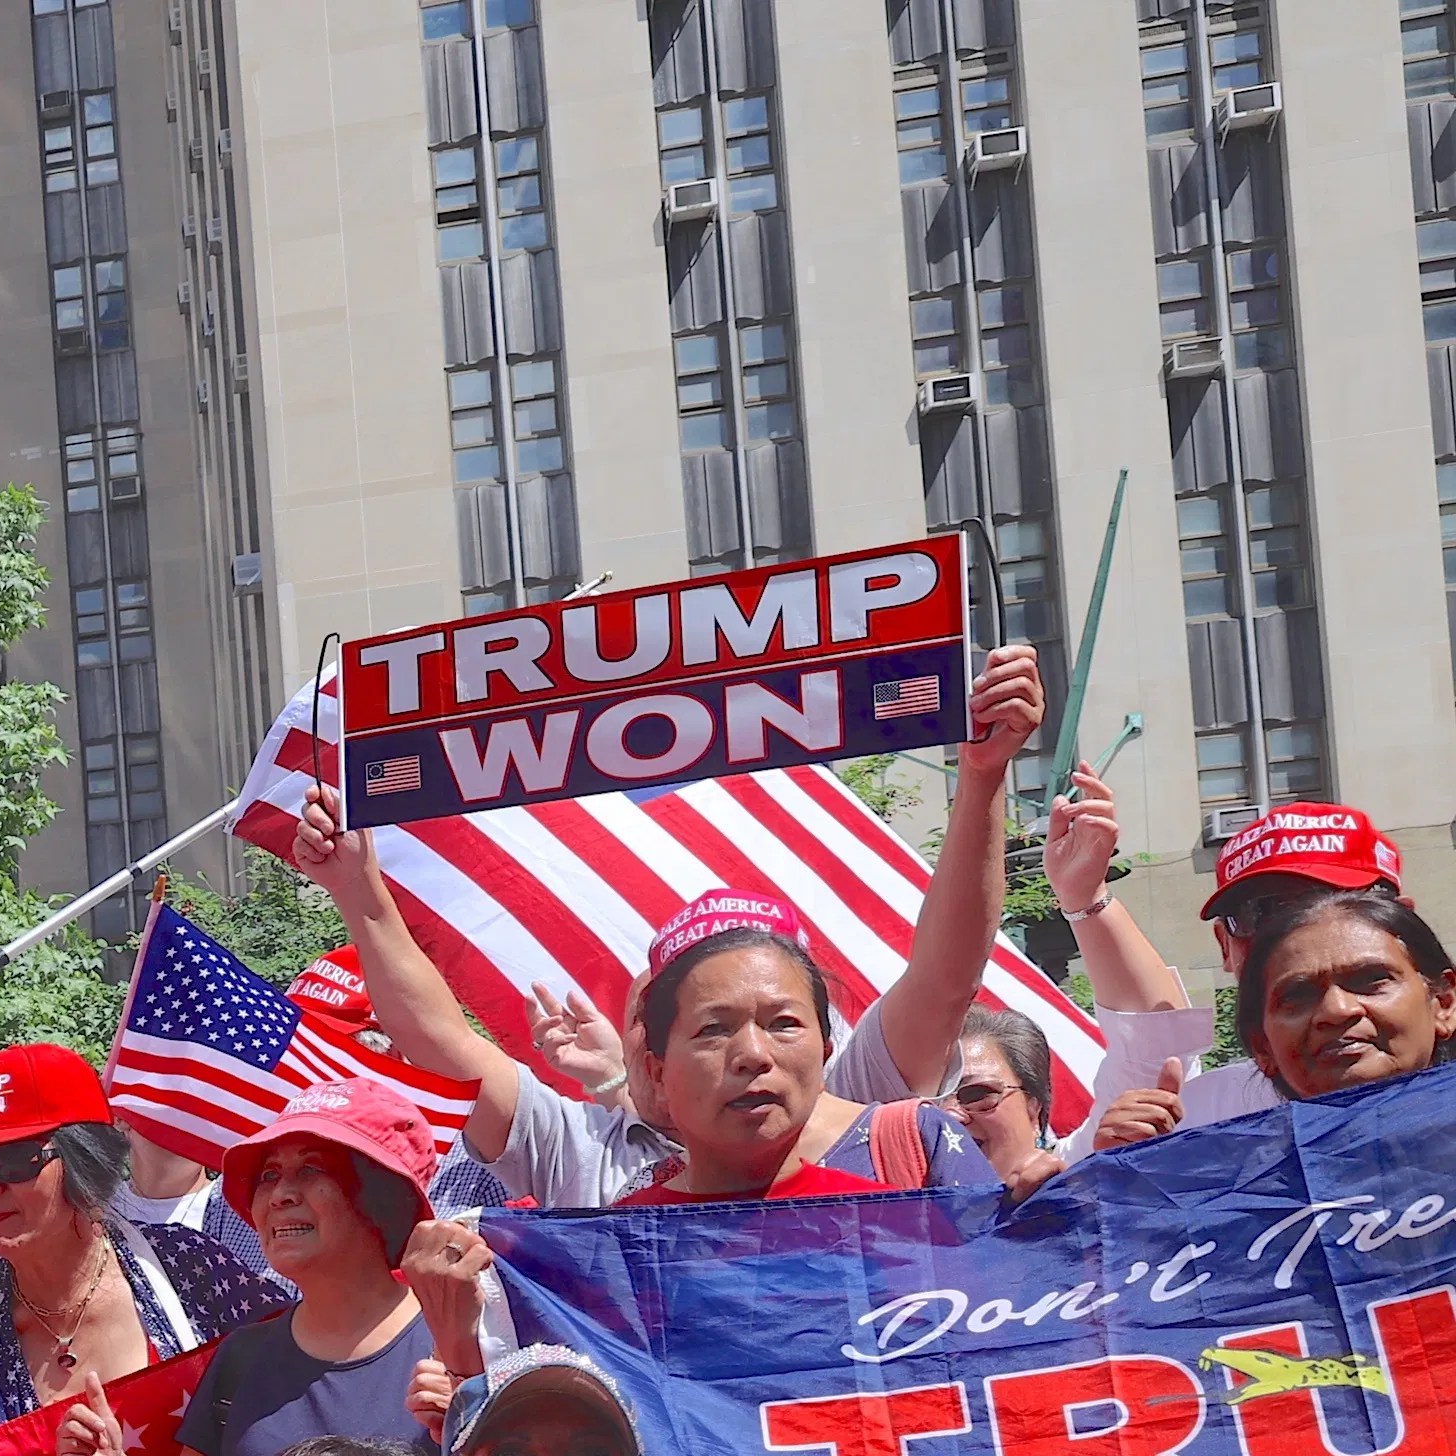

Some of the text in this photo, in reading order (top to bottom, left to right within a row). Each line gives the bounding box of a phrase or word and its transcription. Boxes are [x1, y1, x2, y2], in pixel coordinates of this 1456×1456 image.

[359, 550, 940, 716] TRUMP
[438, 667, 844, 803] WON
[1218, 813, 1358, 863] MAKE AMERICA
[1224, 834, 1346, 882] GREAT AGAIN
[652, 898, 784, 949] MAKE AMERICA
[659, 918, 773, 965] GREAT AGAIN
[300, 980, 350, 1007] AGAIN
[308, 958, 366, 994] MERICA
[841, 1193, 1456, 1363] Don't Tre
